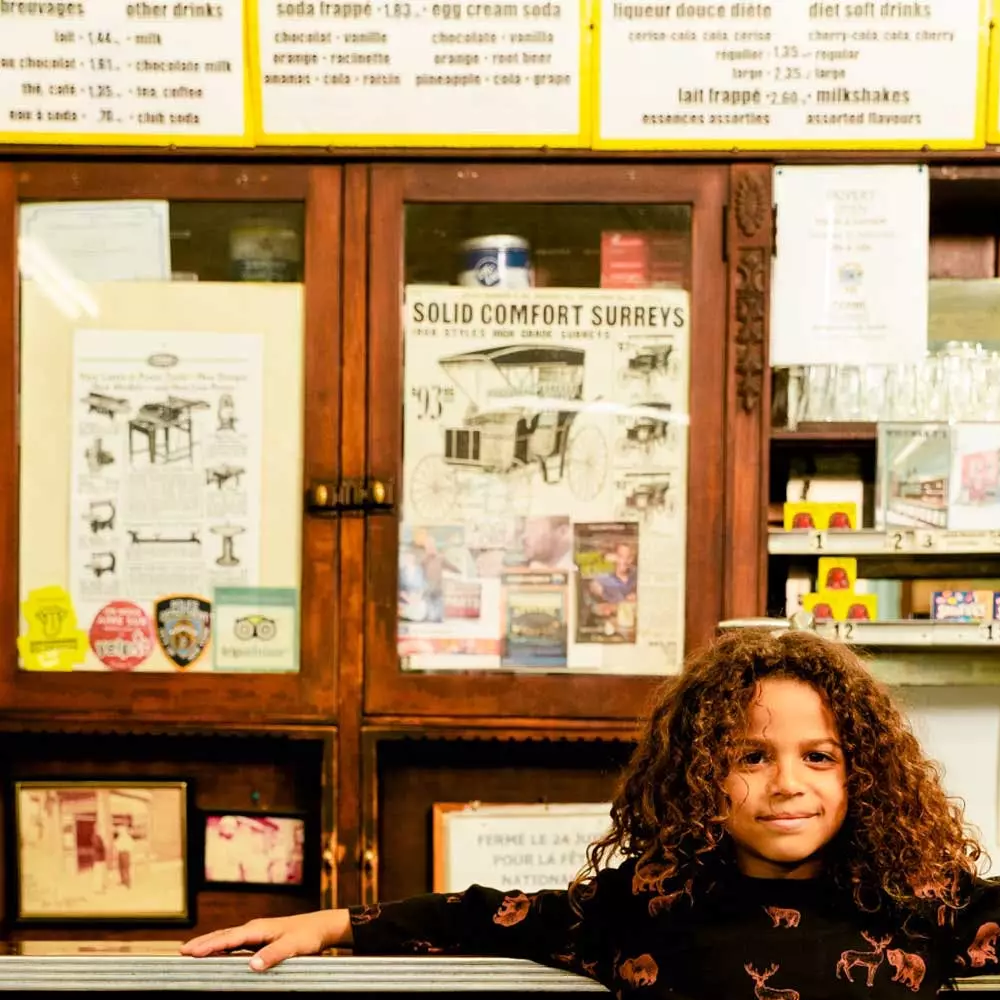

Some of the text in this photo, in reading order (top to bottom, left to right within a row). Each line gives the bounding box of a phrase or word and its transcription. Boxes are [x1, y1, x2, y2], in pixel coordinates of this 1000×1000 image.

[126, 2, 222, 18] other drinks
[277, 1, 314, 17] soda
[432, 4, 461, 20] egg
[466, 4, 517, 18] cream
[523, 2, 561, 18] soda
[614, 3, 671, 20] liqueur
[676, 3, 725, 18] douce
[809, 2, 931, 18] diet soft drinks
[275, 32, 331, 43] chocolat
[432, 32, 497, 44] chocolate
[434, 52, 552, 66] orange root beer
[679, 88, 703, 104] lait
[817, 88, 909, 103] milkshakes
[414, 302, 684, 327] SOLID COMFORT SURREYS
[531, 833, 549, 846] LE
[493, 853, 555, 868] POUR LA
